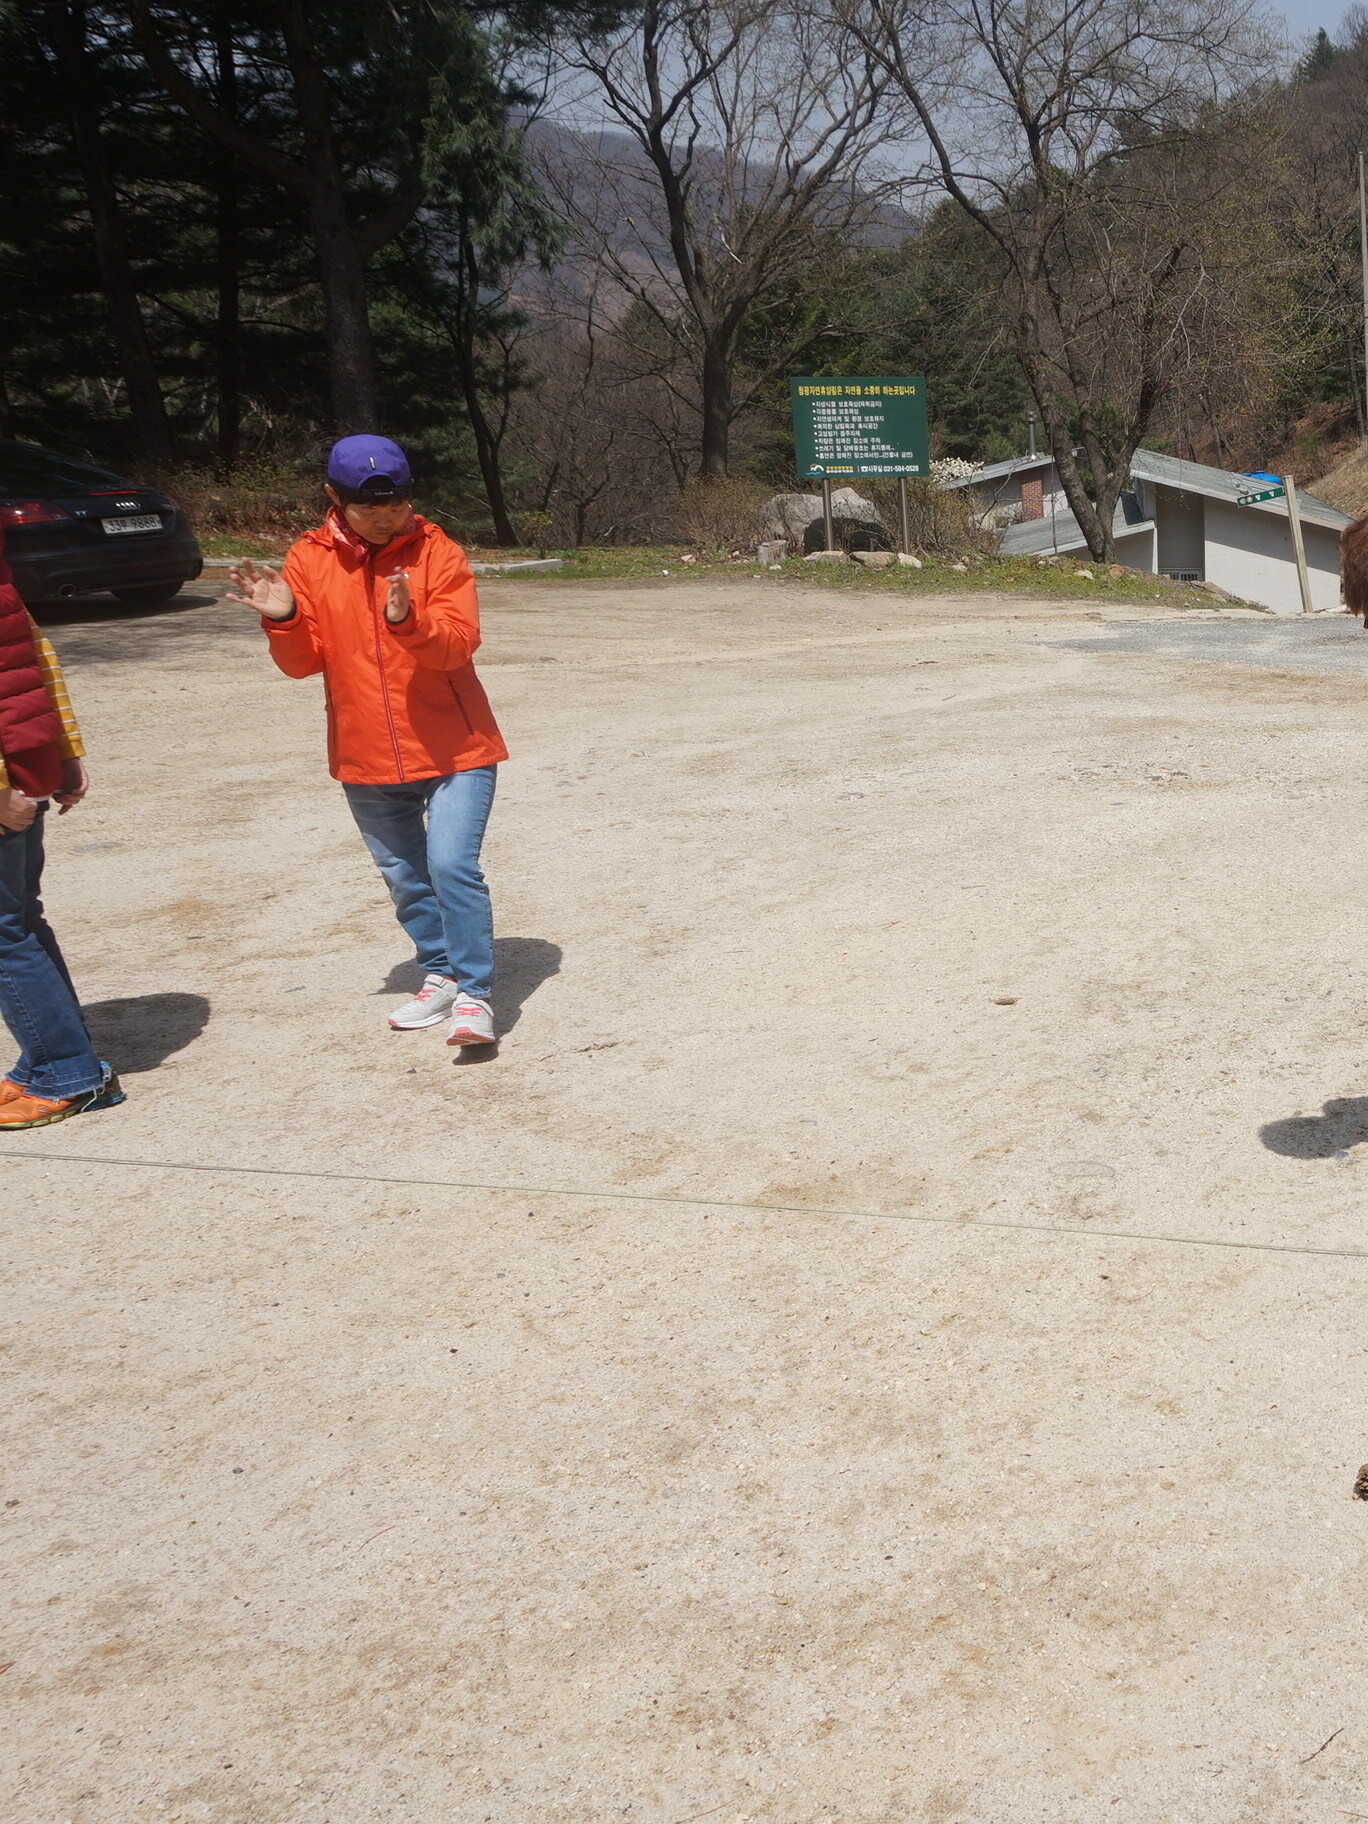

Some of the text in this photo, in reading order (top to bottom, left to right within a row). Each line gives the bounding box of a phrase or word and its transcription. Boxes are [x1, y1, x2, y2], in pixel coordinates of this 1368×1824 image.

[845, 385, 861, 396] 자연을
[864, 385, 881, 396] 소중히
[883, 385, 916, 396] 하는곳입니다
[852, 415, 862, 423] 환경
[853, 437, 869, 445] 장소에
